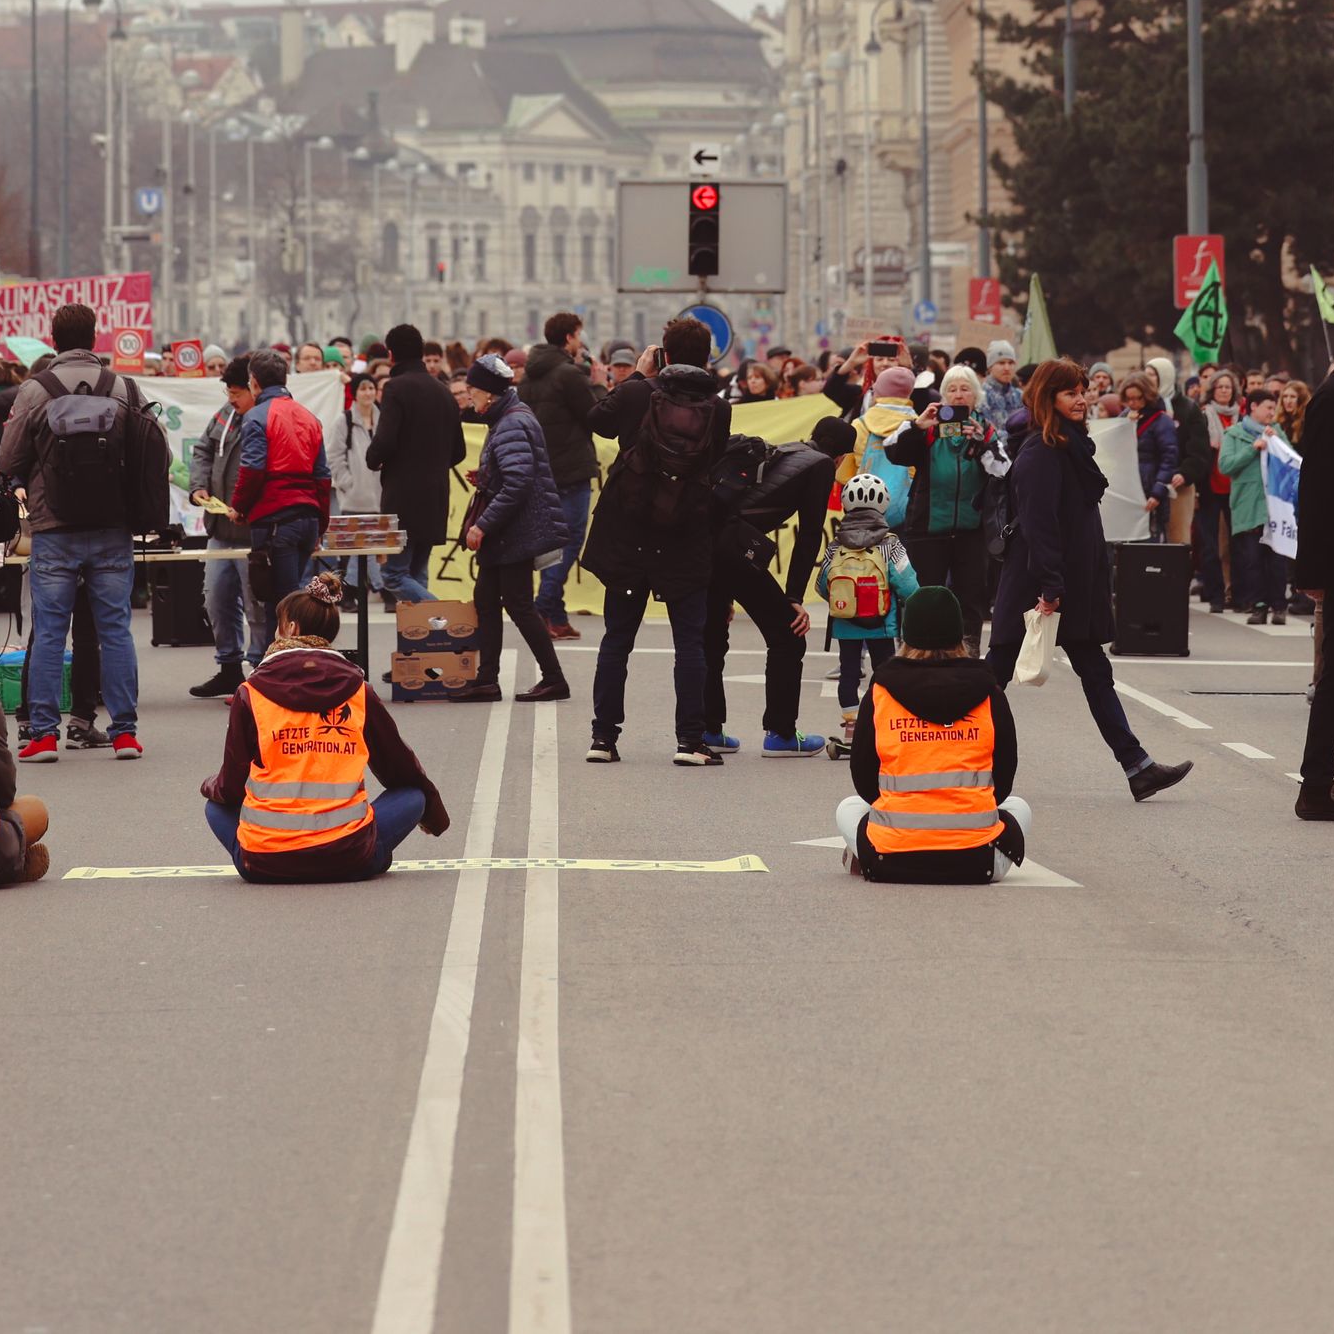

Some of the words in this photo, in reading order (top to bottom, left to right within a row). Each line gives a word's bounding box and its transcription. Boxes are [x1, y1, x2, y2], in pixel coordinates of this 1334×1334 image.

[141, 193, 159, 213] U
[121, 338, 140, 352] 100
[179, 349, 197, 363] 100
[889, 717, 929, 730] LETZTE
[272, 727, 310, 742] LETZTE
[900, 727, 980, 743] GENERATION.AT
[282, 741, 357, 755] GENERATION.AT
